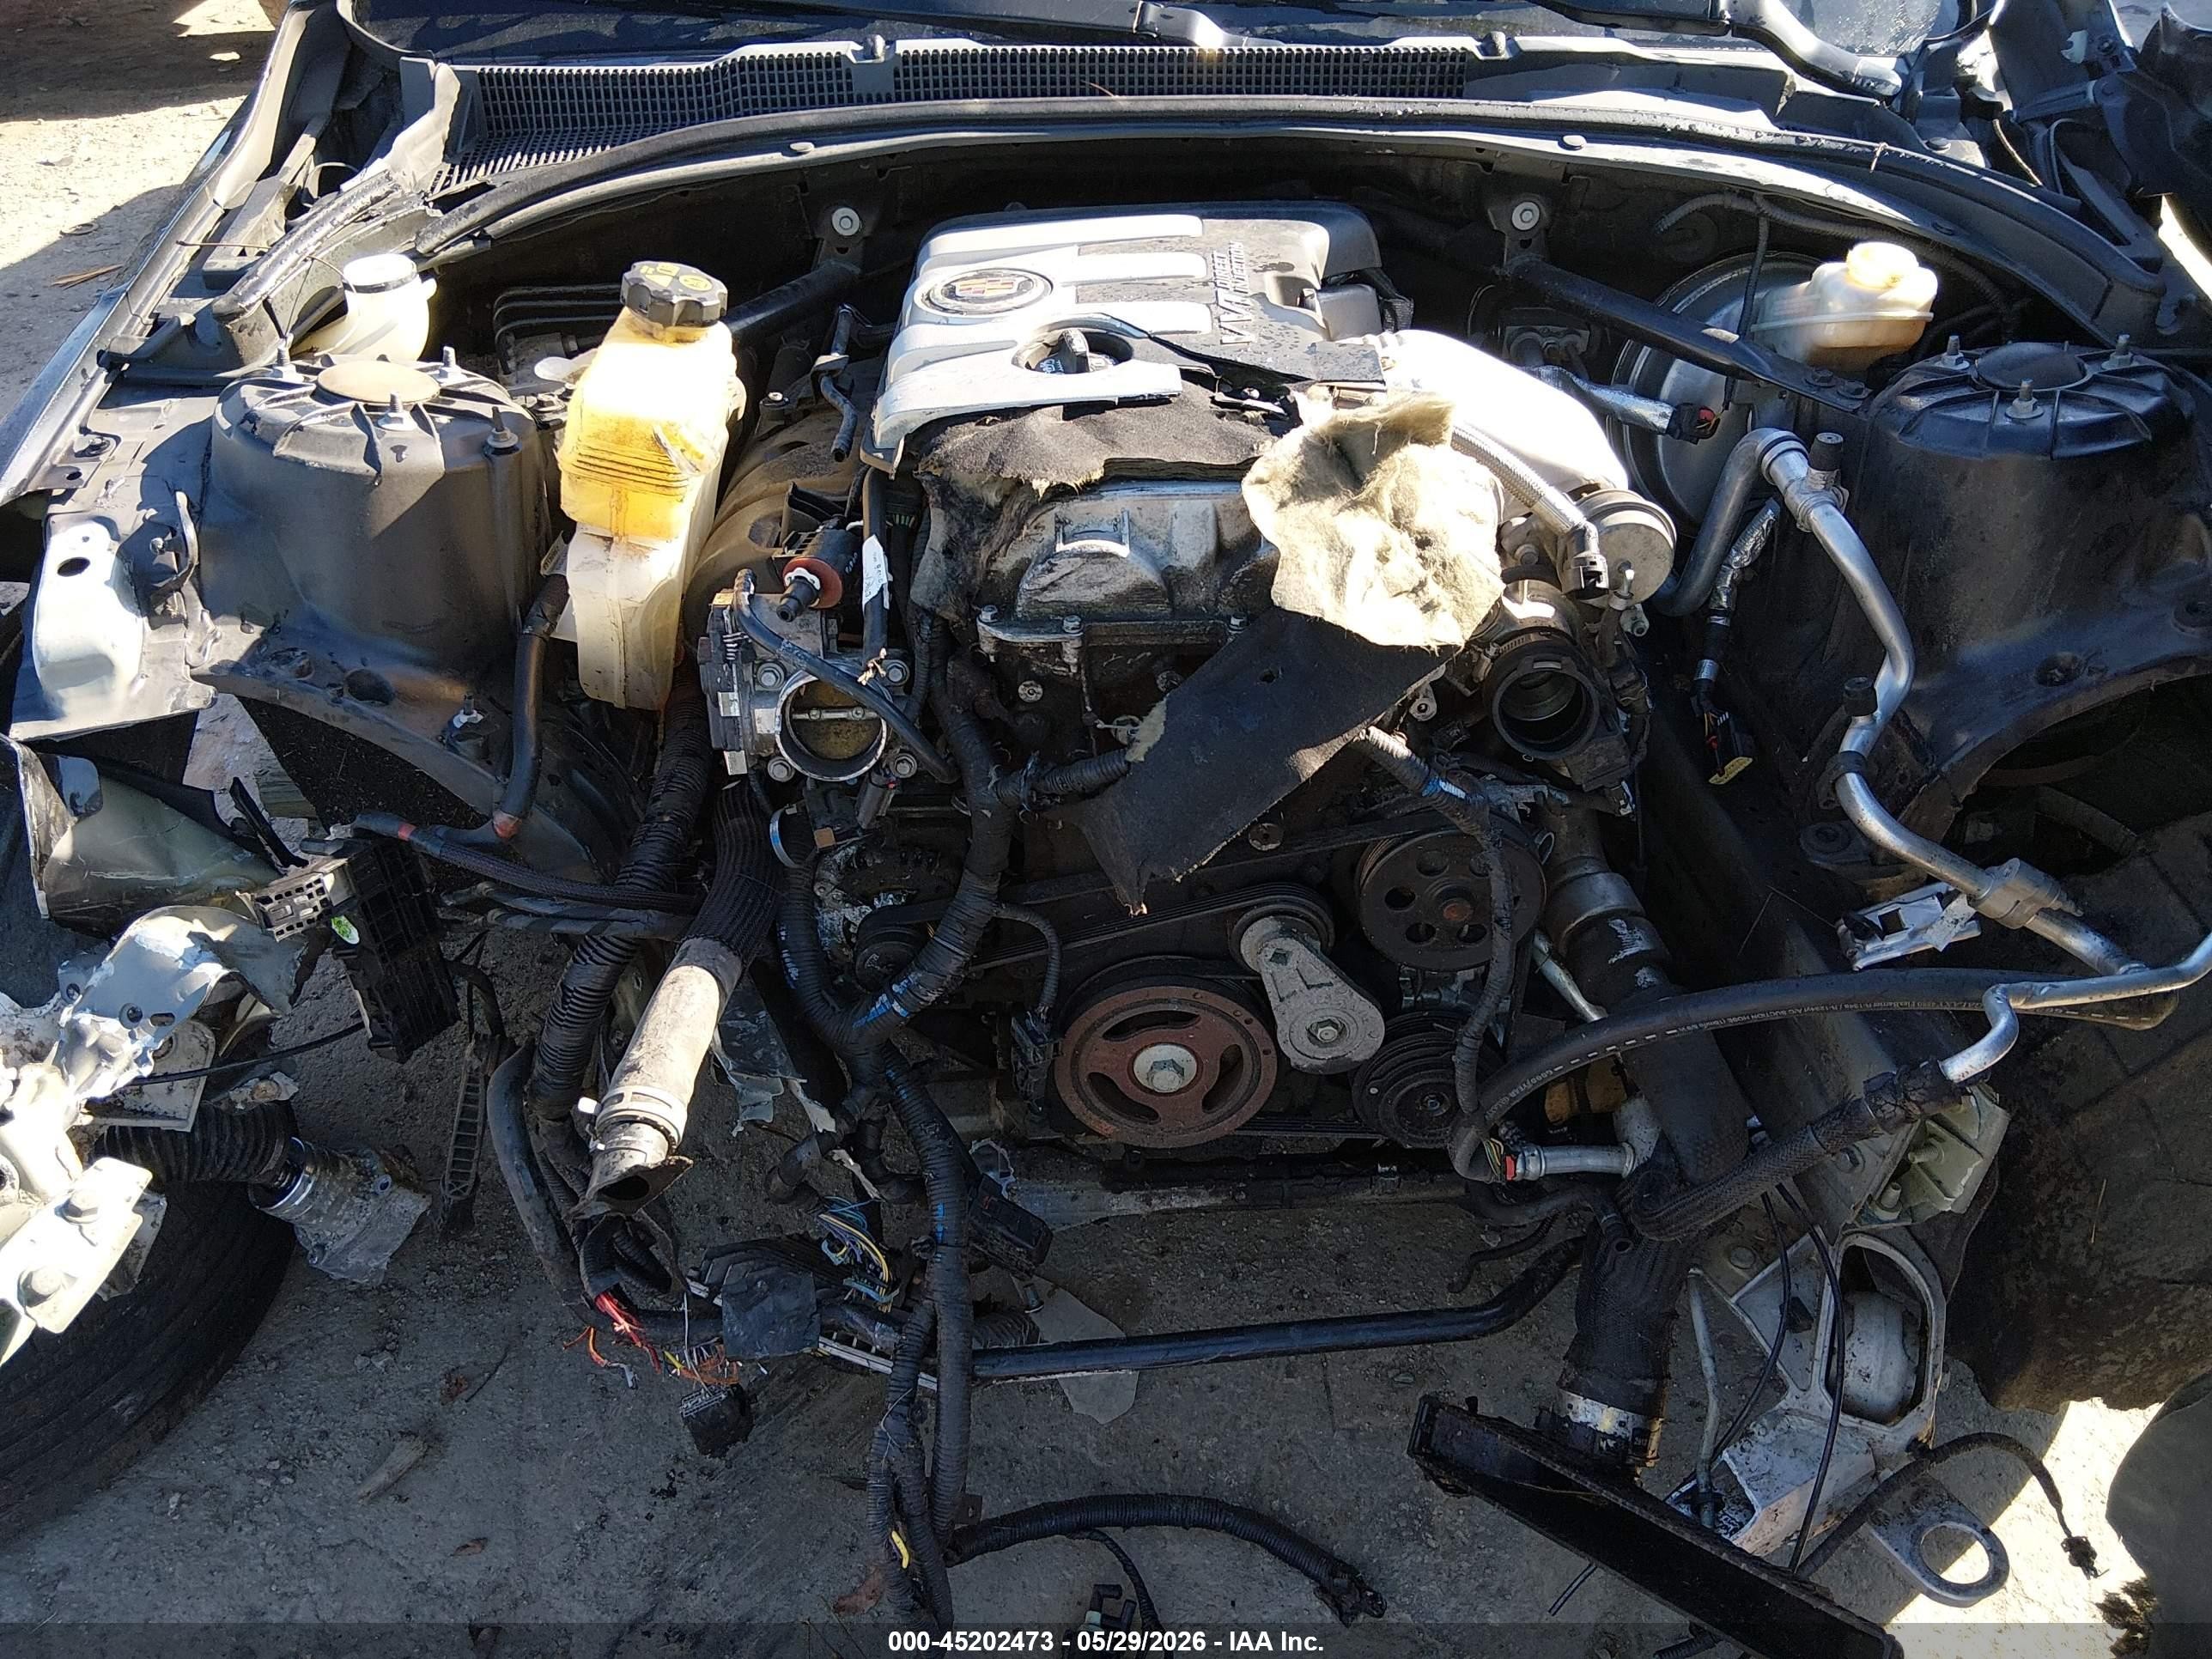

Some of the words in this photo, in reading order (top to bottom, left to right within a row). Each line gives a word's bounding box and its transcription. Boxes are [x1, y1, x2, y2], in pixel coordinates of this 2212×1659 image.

[1212, 250, 1232, 290] DIRECT
[1229, 240, 1250, 295] INJECTION
[1215, 287, 1256, 345] VVT
[1727, 1014, 1750, 1024] HOSE
[1751, 1010, 1786, 1020] SUCTION
[1509, 1069, 1553, 1098] GOODYEAR
